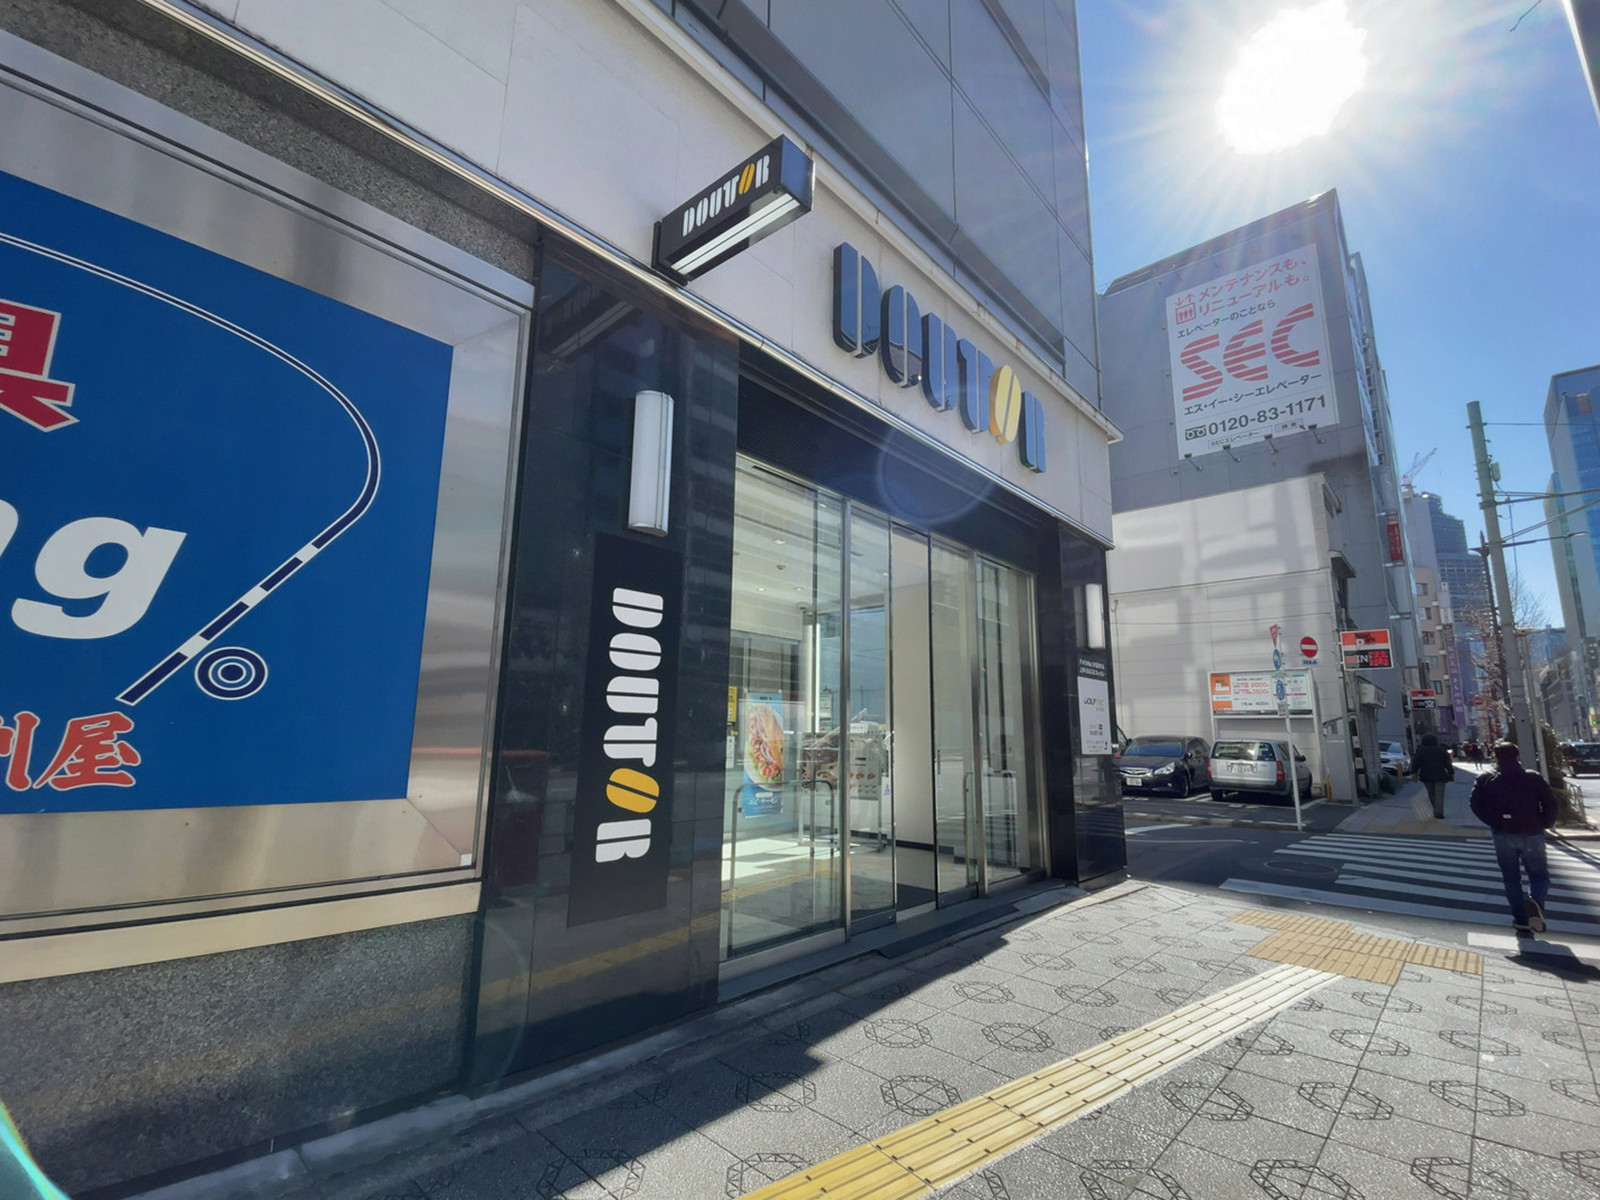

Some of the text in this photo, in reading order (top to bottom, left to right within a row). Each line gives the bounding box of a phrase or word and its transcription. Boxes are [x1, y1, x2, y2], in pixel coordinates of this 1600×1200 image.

[682, 153, 770, 237] DOUTOR
[1198, 257, 1307, 302] メンテナンスも、
[1198, 274, 1310, 317] リニューアルも。
[1177, 300, 1276, 339] エレベーターのことなら
[833, 241, 1047, 475] DOUTOR
[1180, 302, 1321, 402] SEC
[1208, 394, 1326, 435] 0120-83-1171
[0, 499, 187, 640] g
[1356, 654, 1368, 663] IN
[595, 587, 664, 863] DOUTOR
